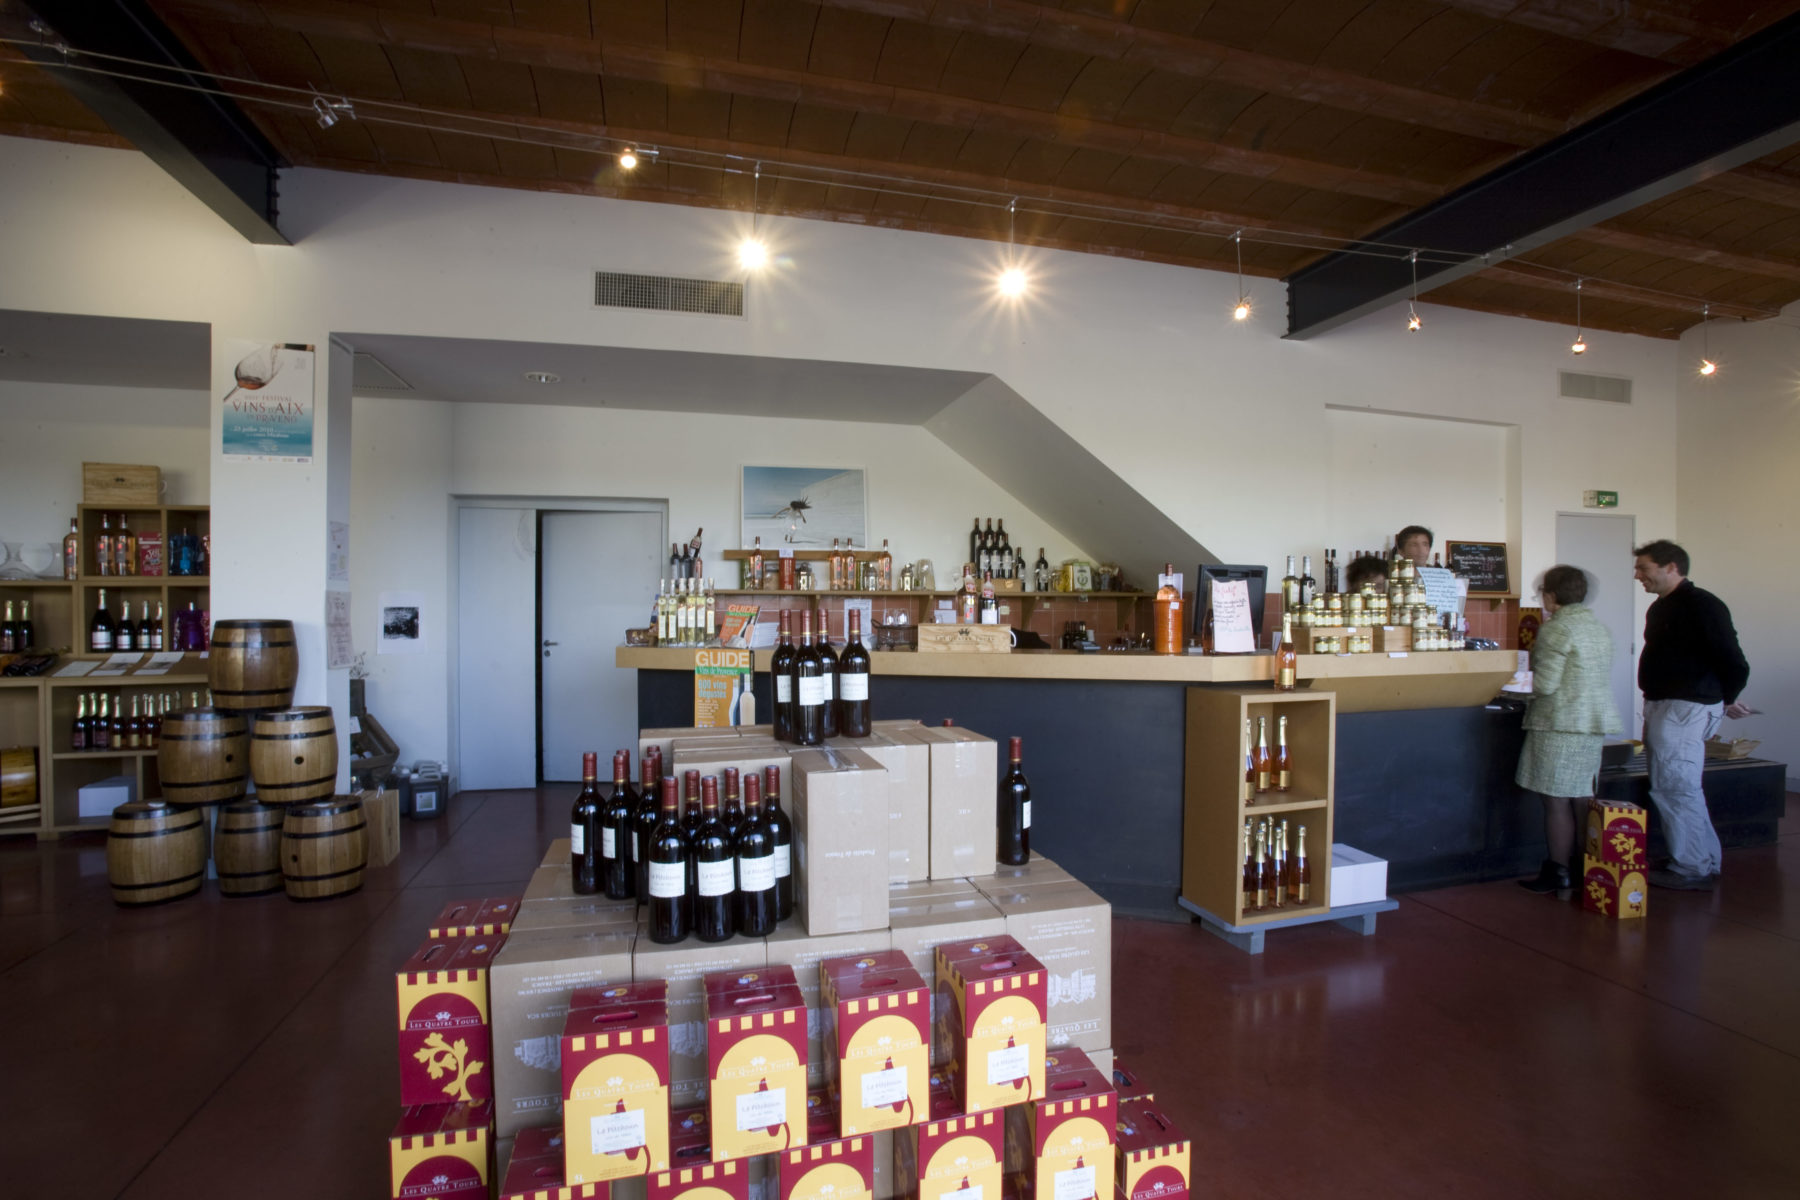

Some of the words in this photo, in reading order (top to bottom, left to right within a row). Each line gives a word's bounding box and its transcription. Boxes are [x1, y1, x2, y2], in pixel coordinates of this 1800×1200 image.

[232, 401, 266, 412] VINS
[728, 604, 759, 613] GUIDE
[696, 650, 750, 668] GUIDE
[409, 1020, 422, 1029] LES
[424, 1019, 453, 1029] QUATRE
[455, 1018, 479, 1026] TOURS
[1050, 1023, 1080, 1034] QUATRE
[516, 1099, 549, 1109] TOURS
[404, 1186, 418, 1196] LES
[420, 1184, 450, 1195] QUATRE
[452, 1180, 478, 1192] TOURS
